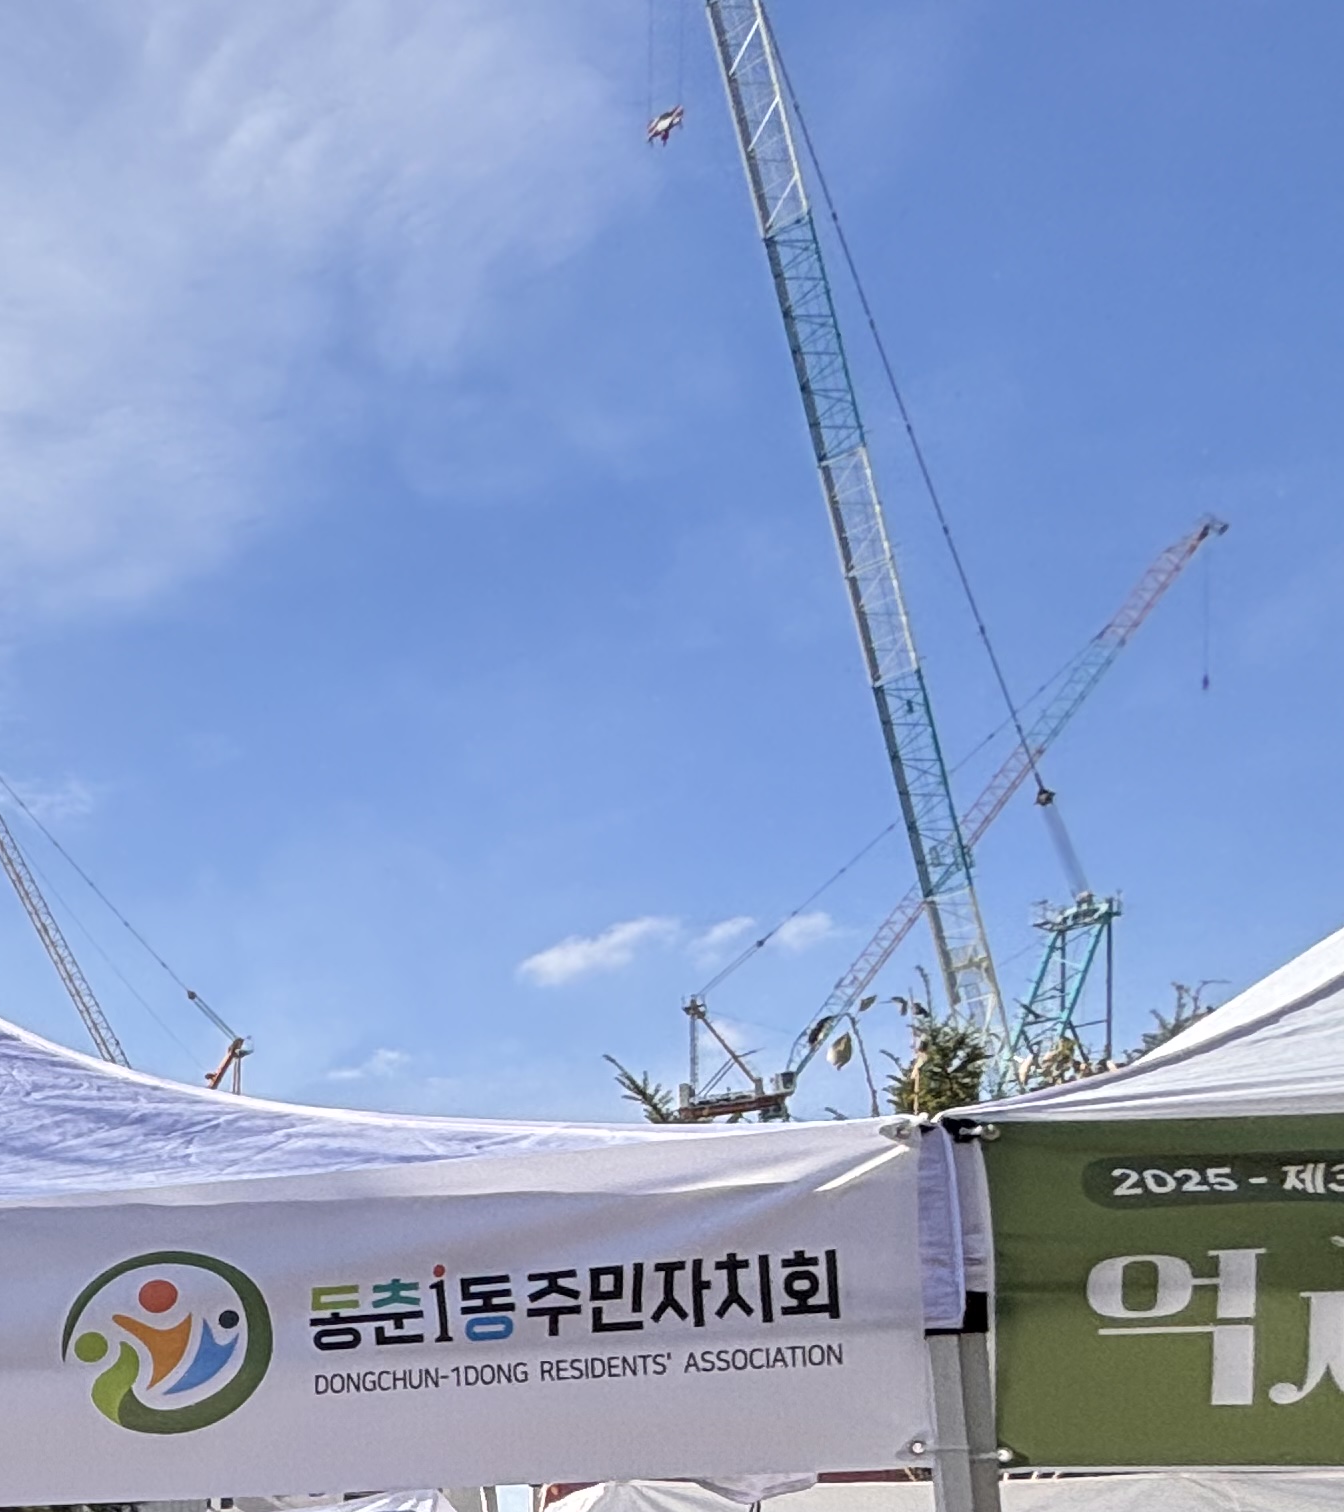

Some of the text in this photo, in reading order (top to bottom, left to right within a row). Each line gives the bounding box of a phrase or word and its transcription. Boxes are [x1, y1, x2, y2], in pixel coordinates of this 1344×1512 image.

[314, 1343, 844, 1396] DONGCHUN-1DONG RESIDENTS' ASSOCIATION
